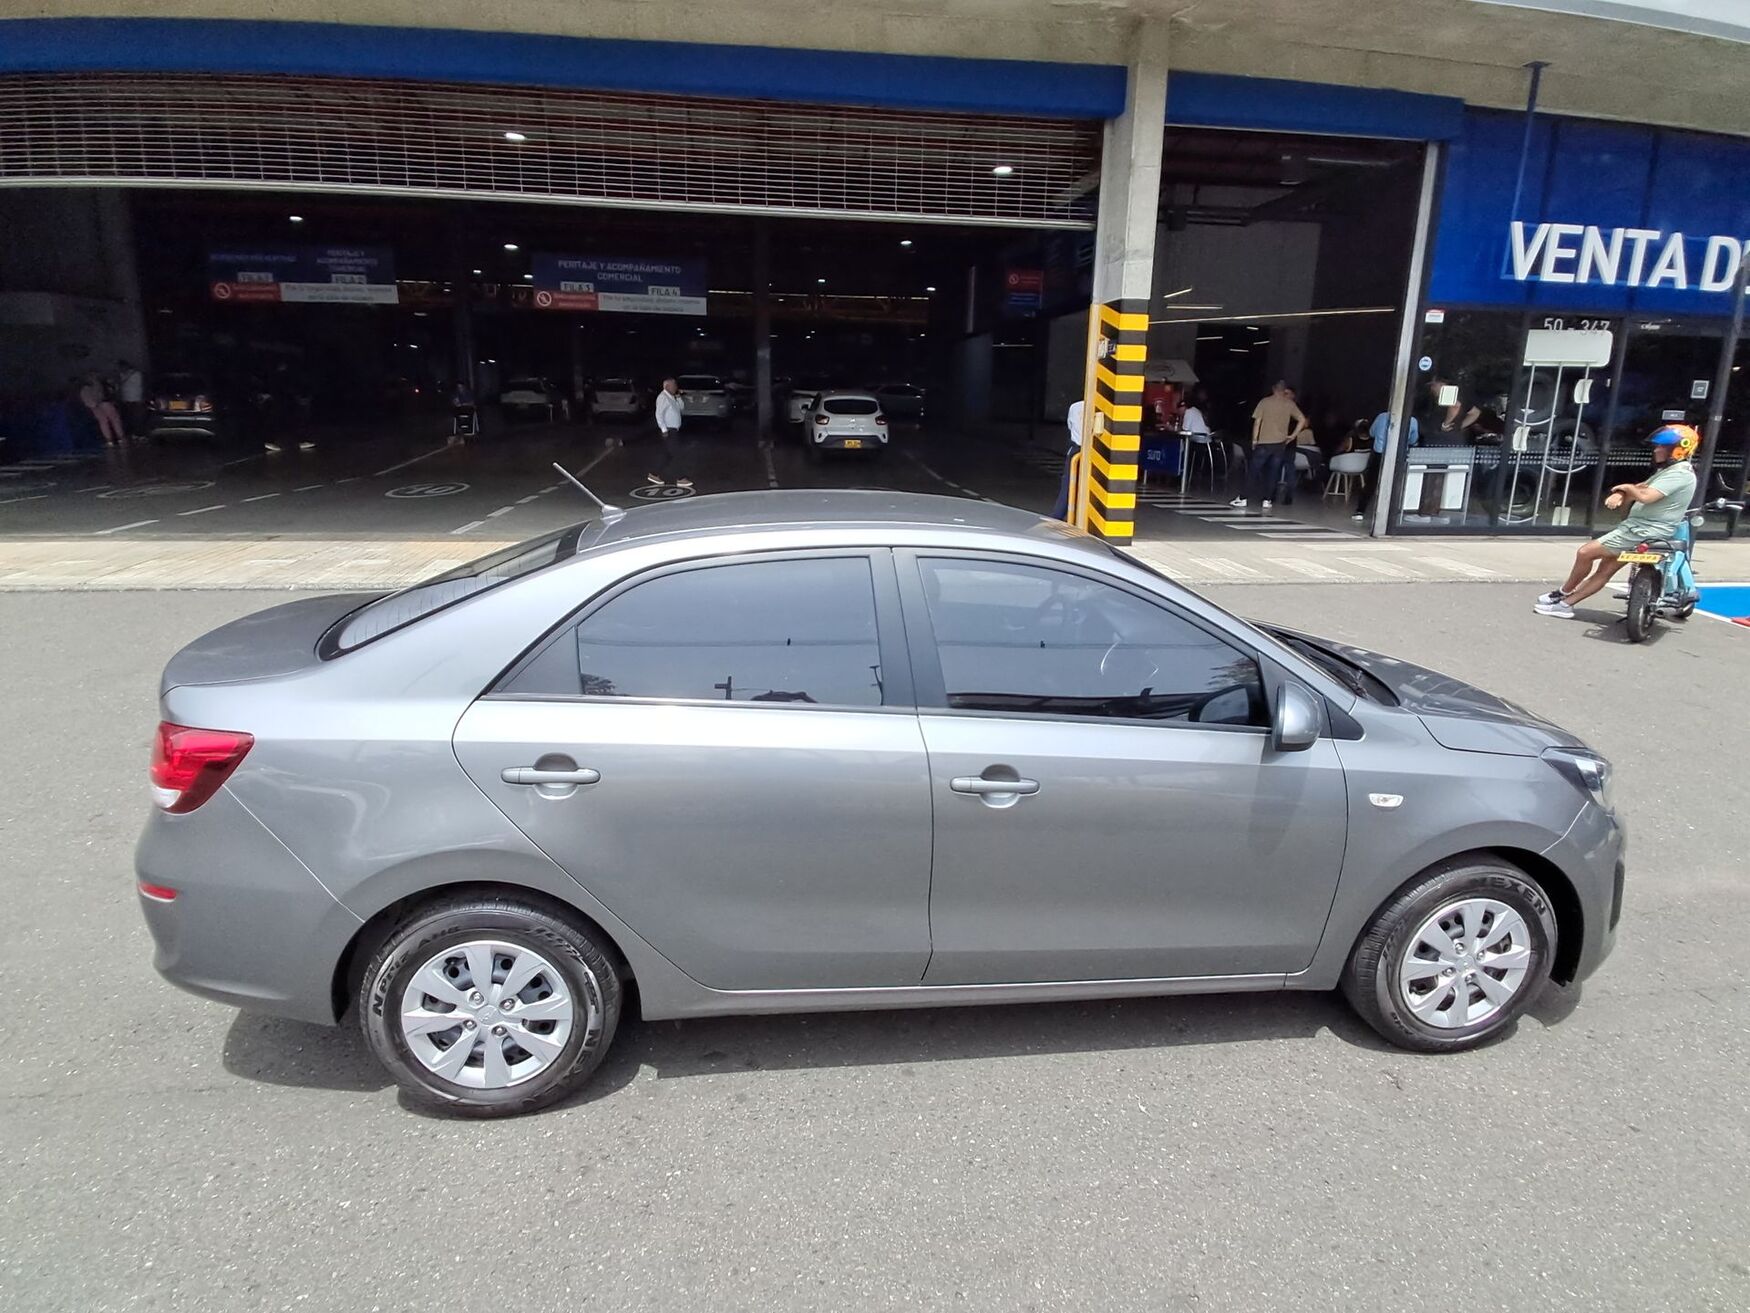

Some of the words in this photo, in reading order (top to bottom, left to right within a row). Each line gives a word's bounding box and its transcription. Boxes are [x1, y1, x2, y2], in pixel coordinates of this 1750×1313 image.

[1510, 221, 1688, 290] VENTA
[1699, 235, 1750, 294] D
[558, 260, 597, 271] PERITAJE
[597, 273, 644, 283] COMERCIAL
[651, 287, 670, 297] FILA
